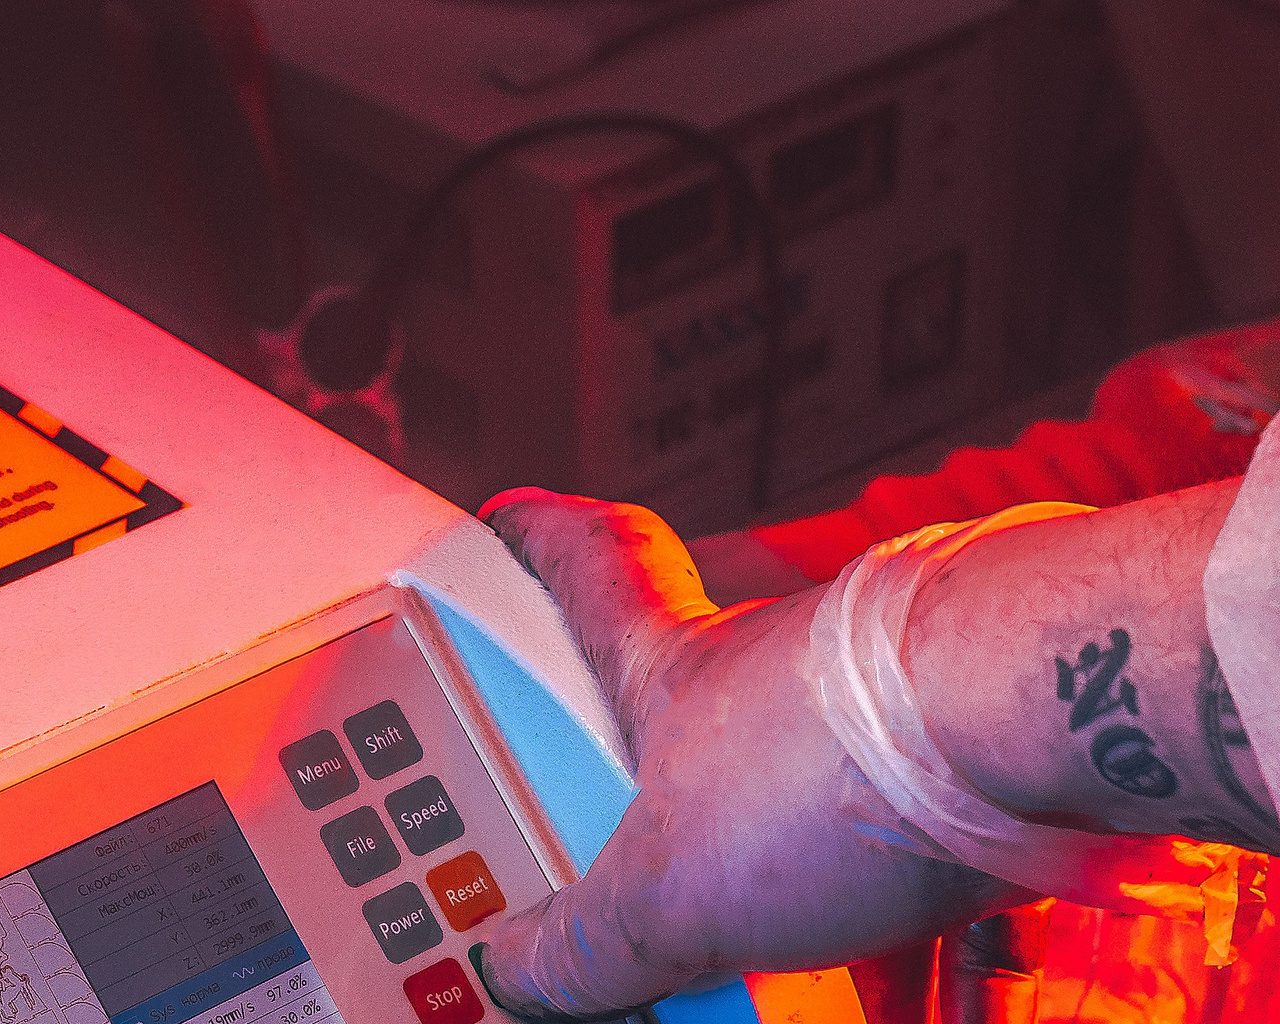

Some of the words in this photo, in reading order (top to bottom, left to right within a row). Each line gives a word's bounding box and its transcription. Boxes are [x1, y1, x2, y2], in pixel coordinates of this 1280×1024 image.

[10, 479, 59, 502] during
[364, 725, 403, 754] Shift
[295, 757, 341, 785] Menu
[399, 794, 448, 830] Speed
[345, 836, 376, 858] File
[444, 875, 489, 906] Reset
[378, 907, 425, 939] Power
[265, 971, 307, 1002] 97.0%
[425, 985, 462, 1011] Stop
[148, 1004, 176, 1023] Sys
[180, 981, 221, 1006] норма
